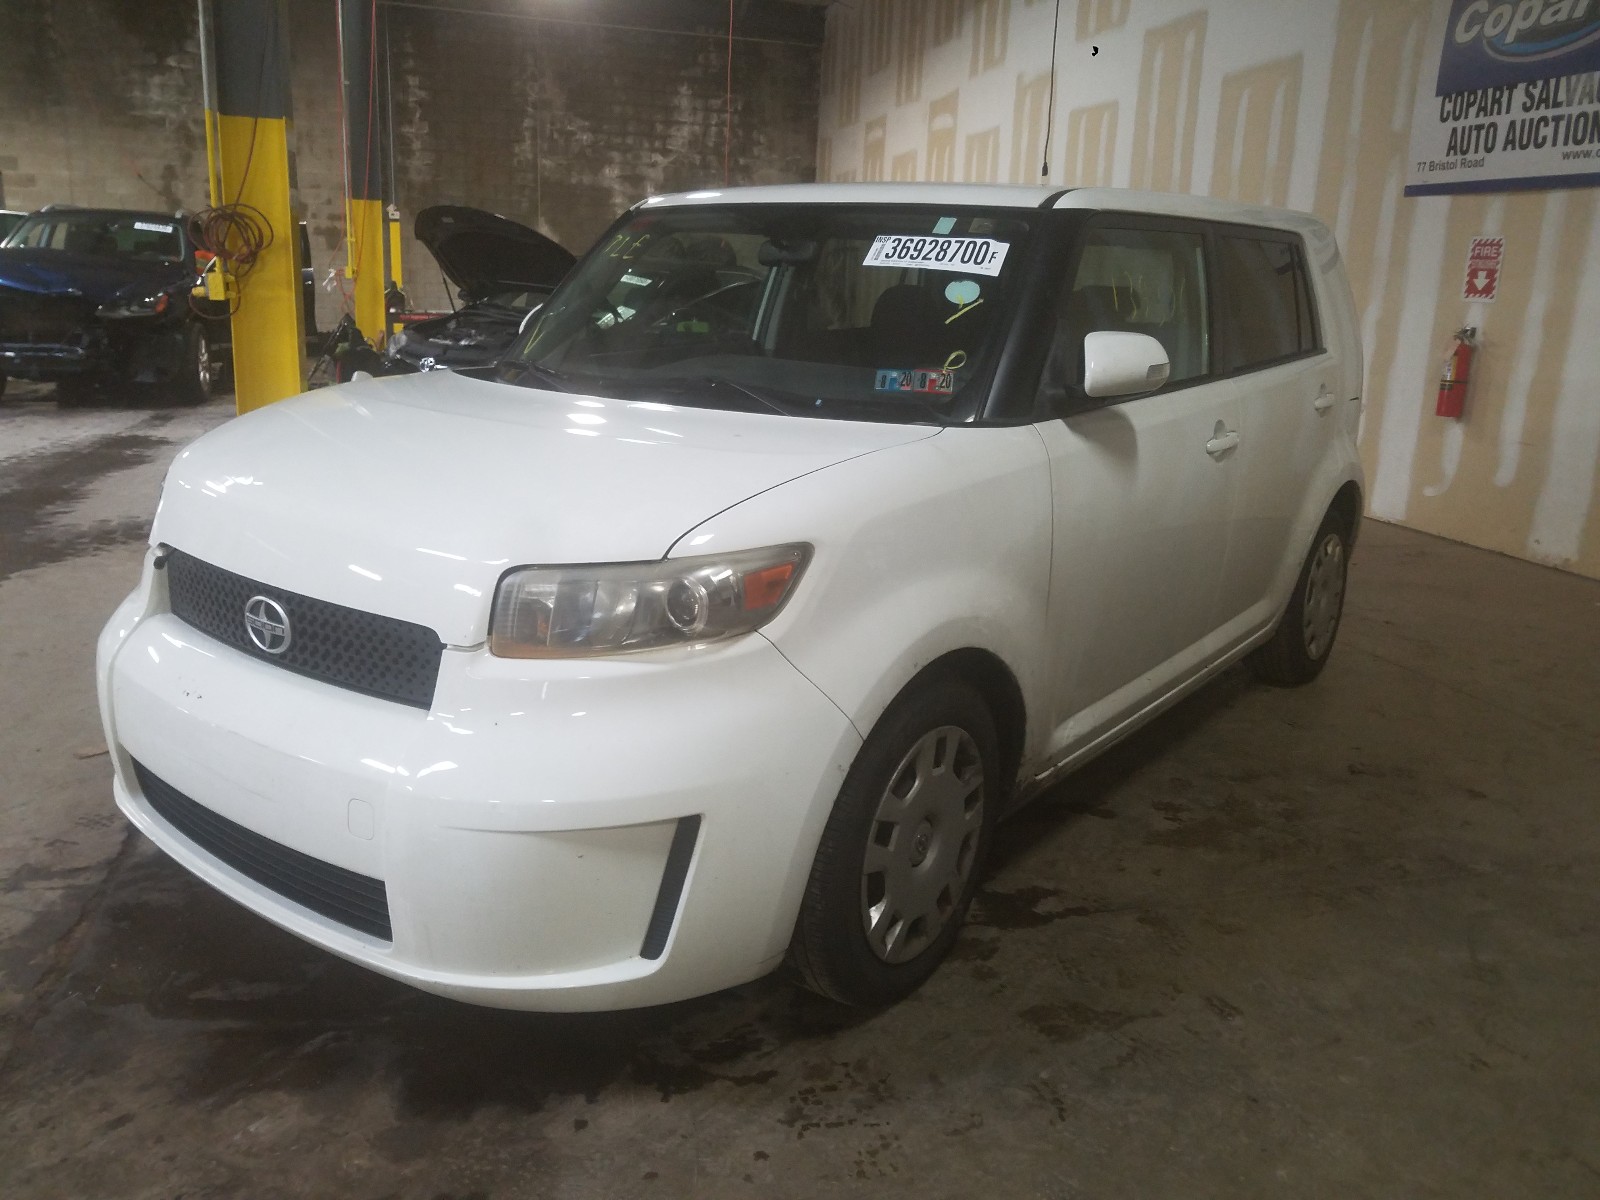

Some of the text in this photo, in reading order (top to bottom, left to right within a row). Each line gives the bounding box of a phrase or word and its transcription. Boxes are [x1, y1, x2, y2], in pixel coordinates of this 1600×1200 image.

[1440, 73, 1600, 123] COPART SALVA
[1446, 121, 1498, 157] AUTO
[1416, 157, 1485, 172] 77 Bristol Road
[885, 237, 991, 265] 36928700
[987, 252, 999, 264] F
[1474, 246, 1499, 257] FIRE
[901, 372, 912, 387] 20
[919, 373, 952, 388] 8 20
